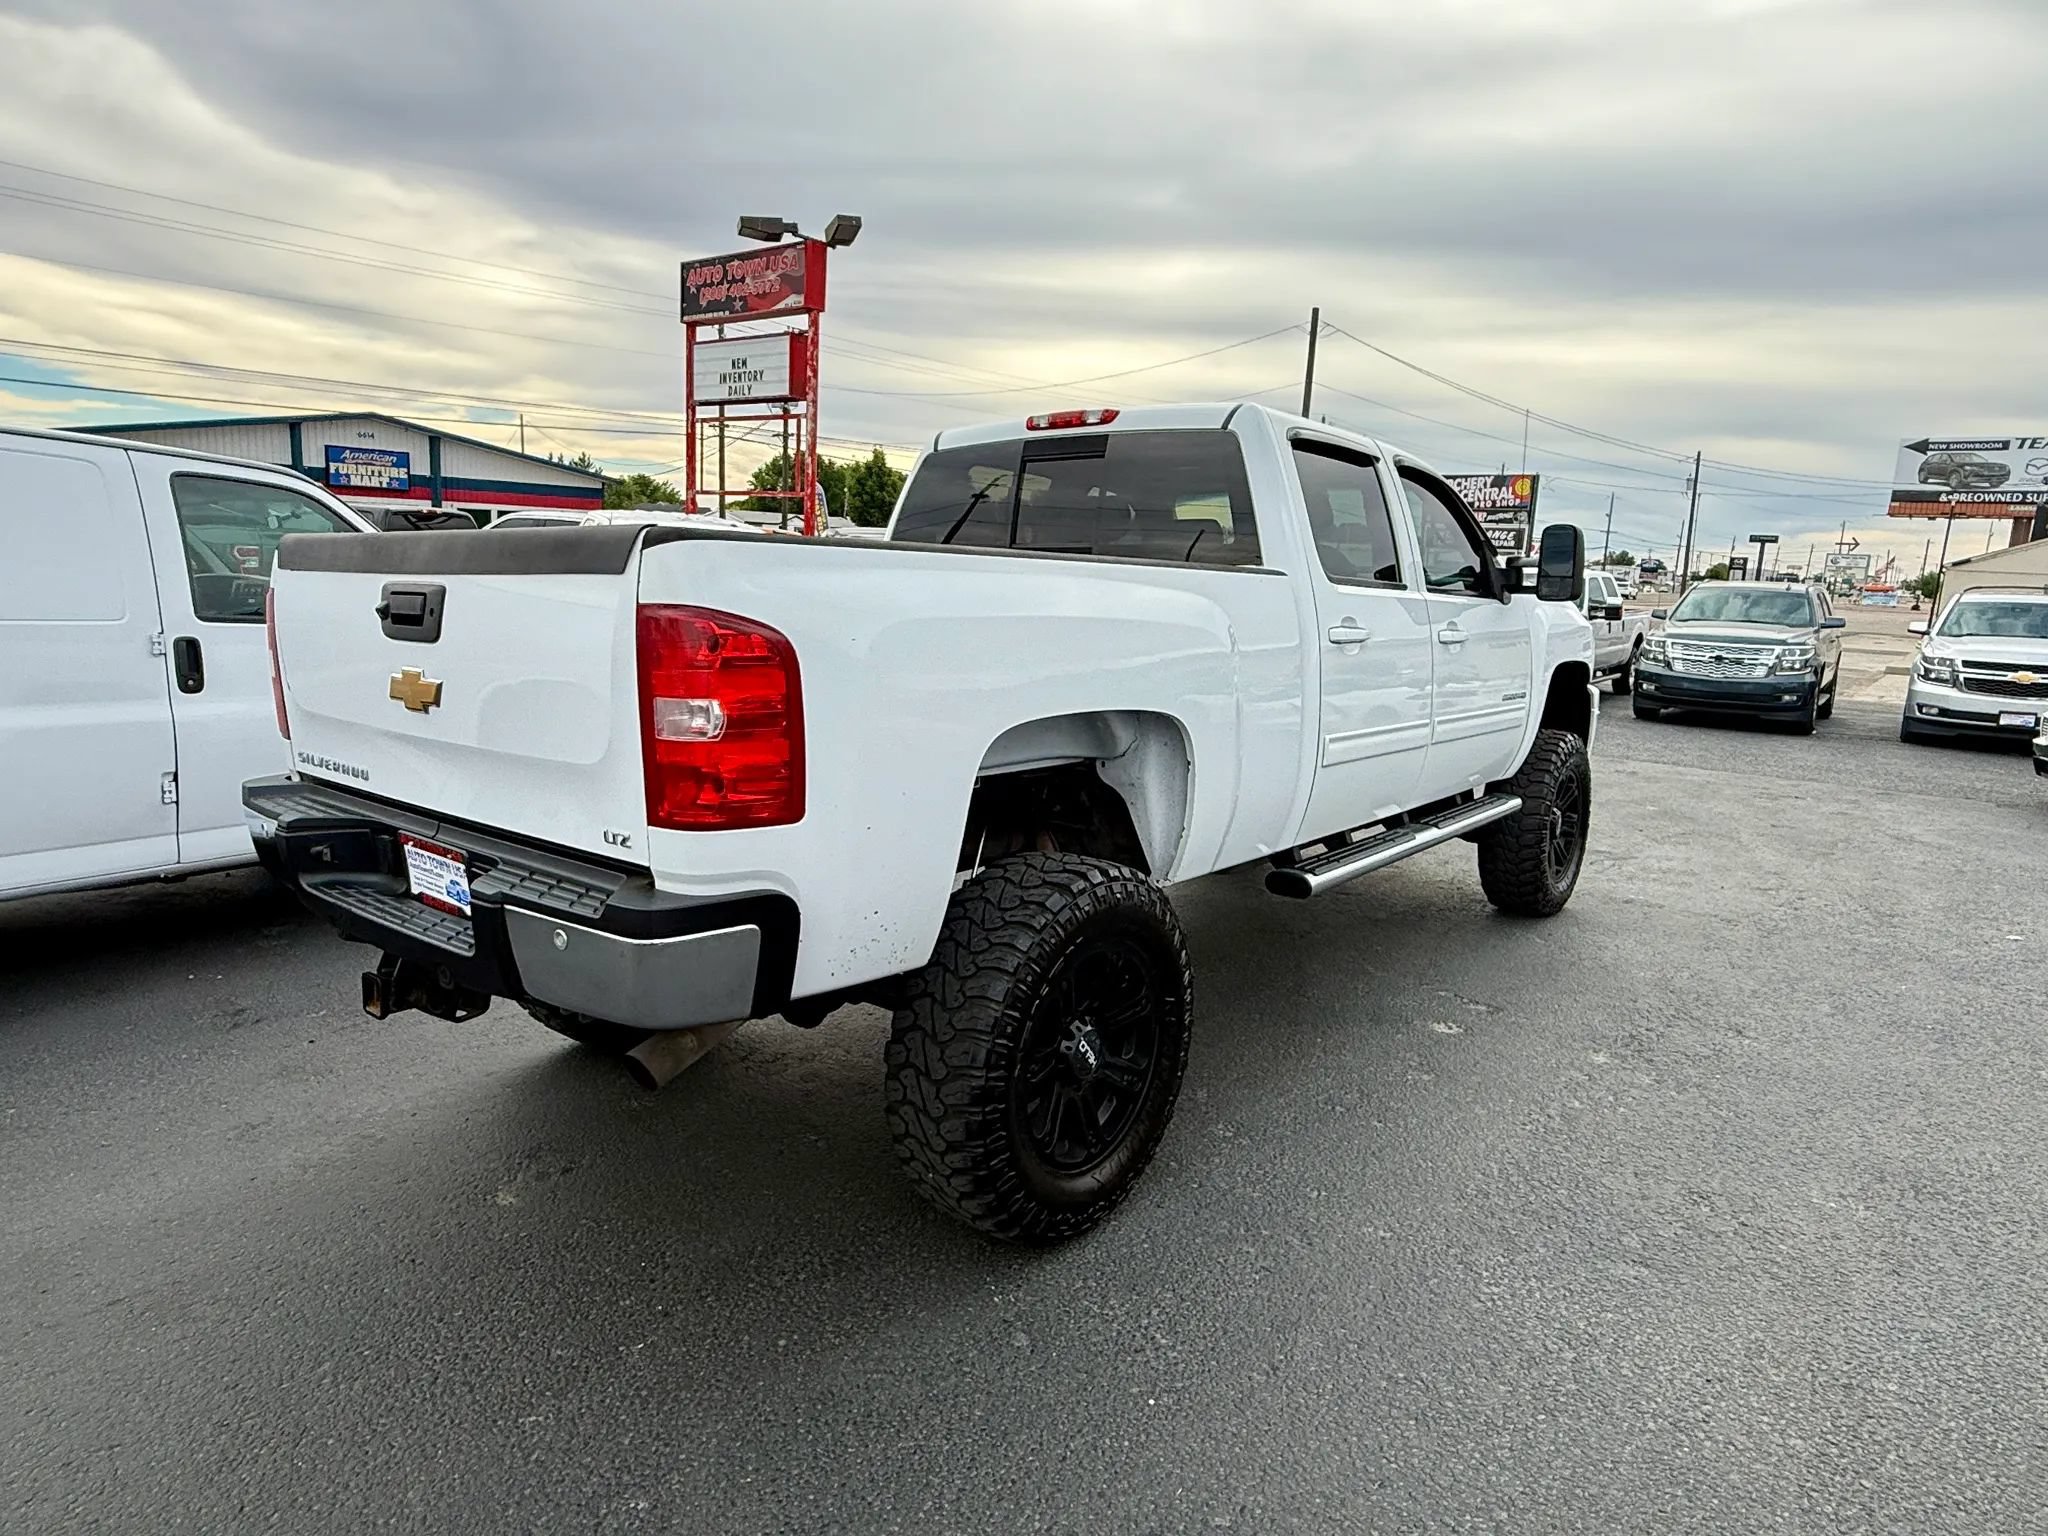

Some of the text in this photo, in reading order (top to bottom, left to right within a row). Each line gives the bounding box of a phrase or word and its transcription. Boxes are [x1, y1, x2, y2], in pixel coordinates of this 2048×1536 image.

[686, 254, 799, 286] AUTO TOWN USA
[731, 357, 748, 370] NEW
[719, 370, 765, 385] INVENTORY
[727, 384, 753, 397] DAILY
[1949, 442, 2003, 450] SHOWROOM
[340, 449, 398, 463] American
[329, 463, 408, 478] FURNITURE
[350, 474, 390, 488] MART
[1460, 486, 1515, 502] CENTRAL
[1938, 492, 1948, 502] &
[1953, 492, 2023, 502] PREOWNED
[1474, 498, 1521, 509] PRO SHOP
[603, 829, 632, 849] LTZ
[407, 848, 428, 866] AUTO
[427, 855, 452, 875] TOWN
